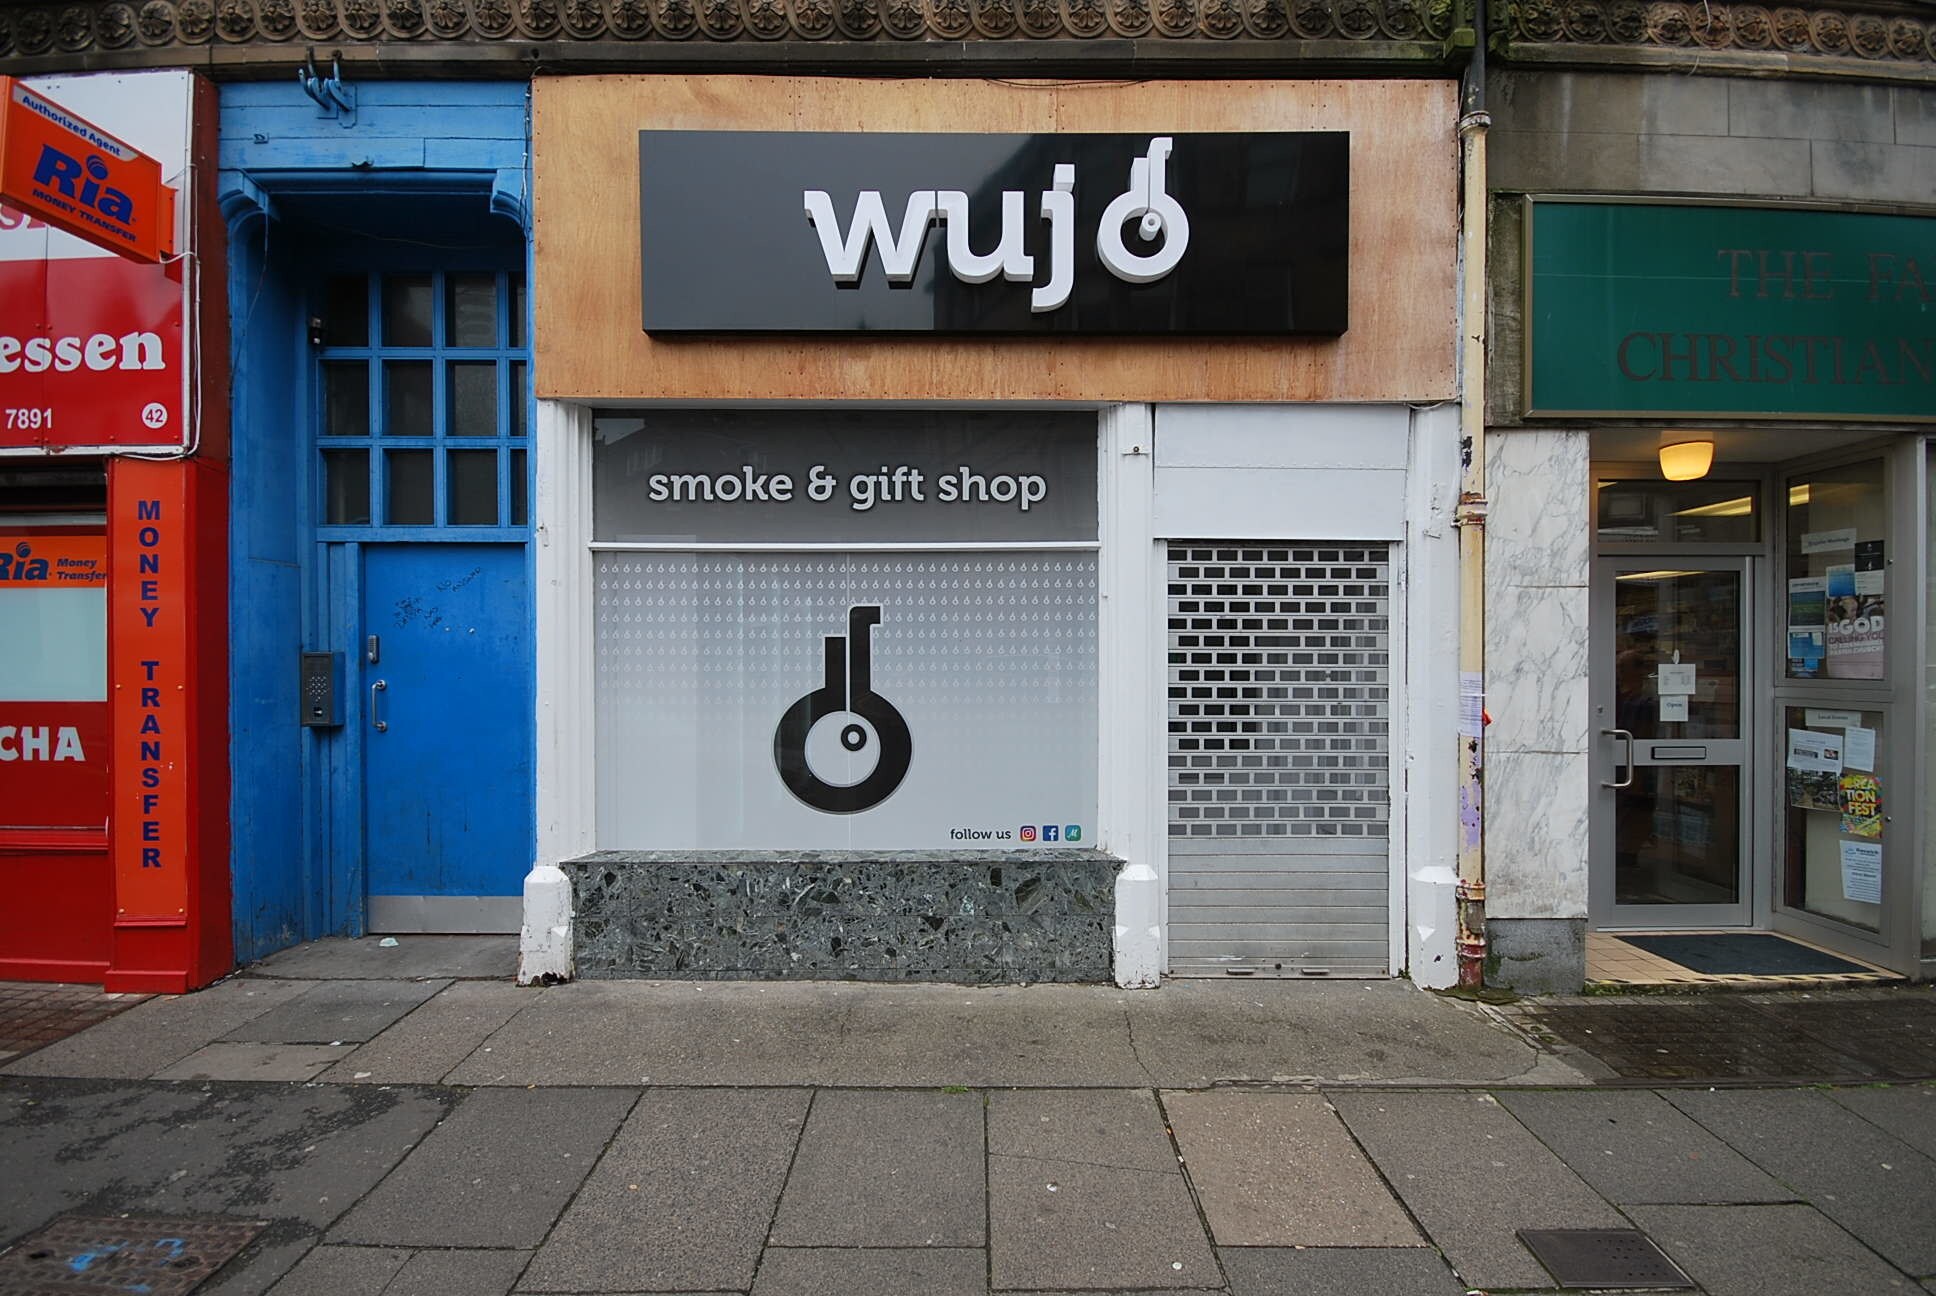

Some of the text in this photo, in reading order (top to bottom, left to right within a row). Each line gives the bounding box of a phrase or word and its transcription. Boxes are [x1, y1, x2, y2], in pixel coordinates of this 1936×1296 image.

[22, 96, 121, 157] Authorized Agent
[32, 144, 134, 225] Ria
[32, 189, 77, 213] MONEY
[79, 210, 137, 242] TRANSFER
[804, 137, 1190, 313] wujo
[1715, 248, 1836, 301] THE
[0, 332, 166, 373] essen
[1617, 330, 1936, 386] CHRISTIAN
[5, 408, 53, 429] 7891
[145, 409, 164, 423] 42
[648, 465, 1048, 511] smoke & gift shop
[0, 541, 49, 580] Ria
[57, 558, 97, 569] Money
[57, 571, 106, 582] Transfer
[1839, 616, 1884, 635] GOD
[138, 501, 162, 869] MONEY TRANSFER
[0, 726, 86, 762] CHA
[1848, 802, 1877, 816] FEST
[950, 828, 993, 840] follow
[996, 829, 1012, 840] us
